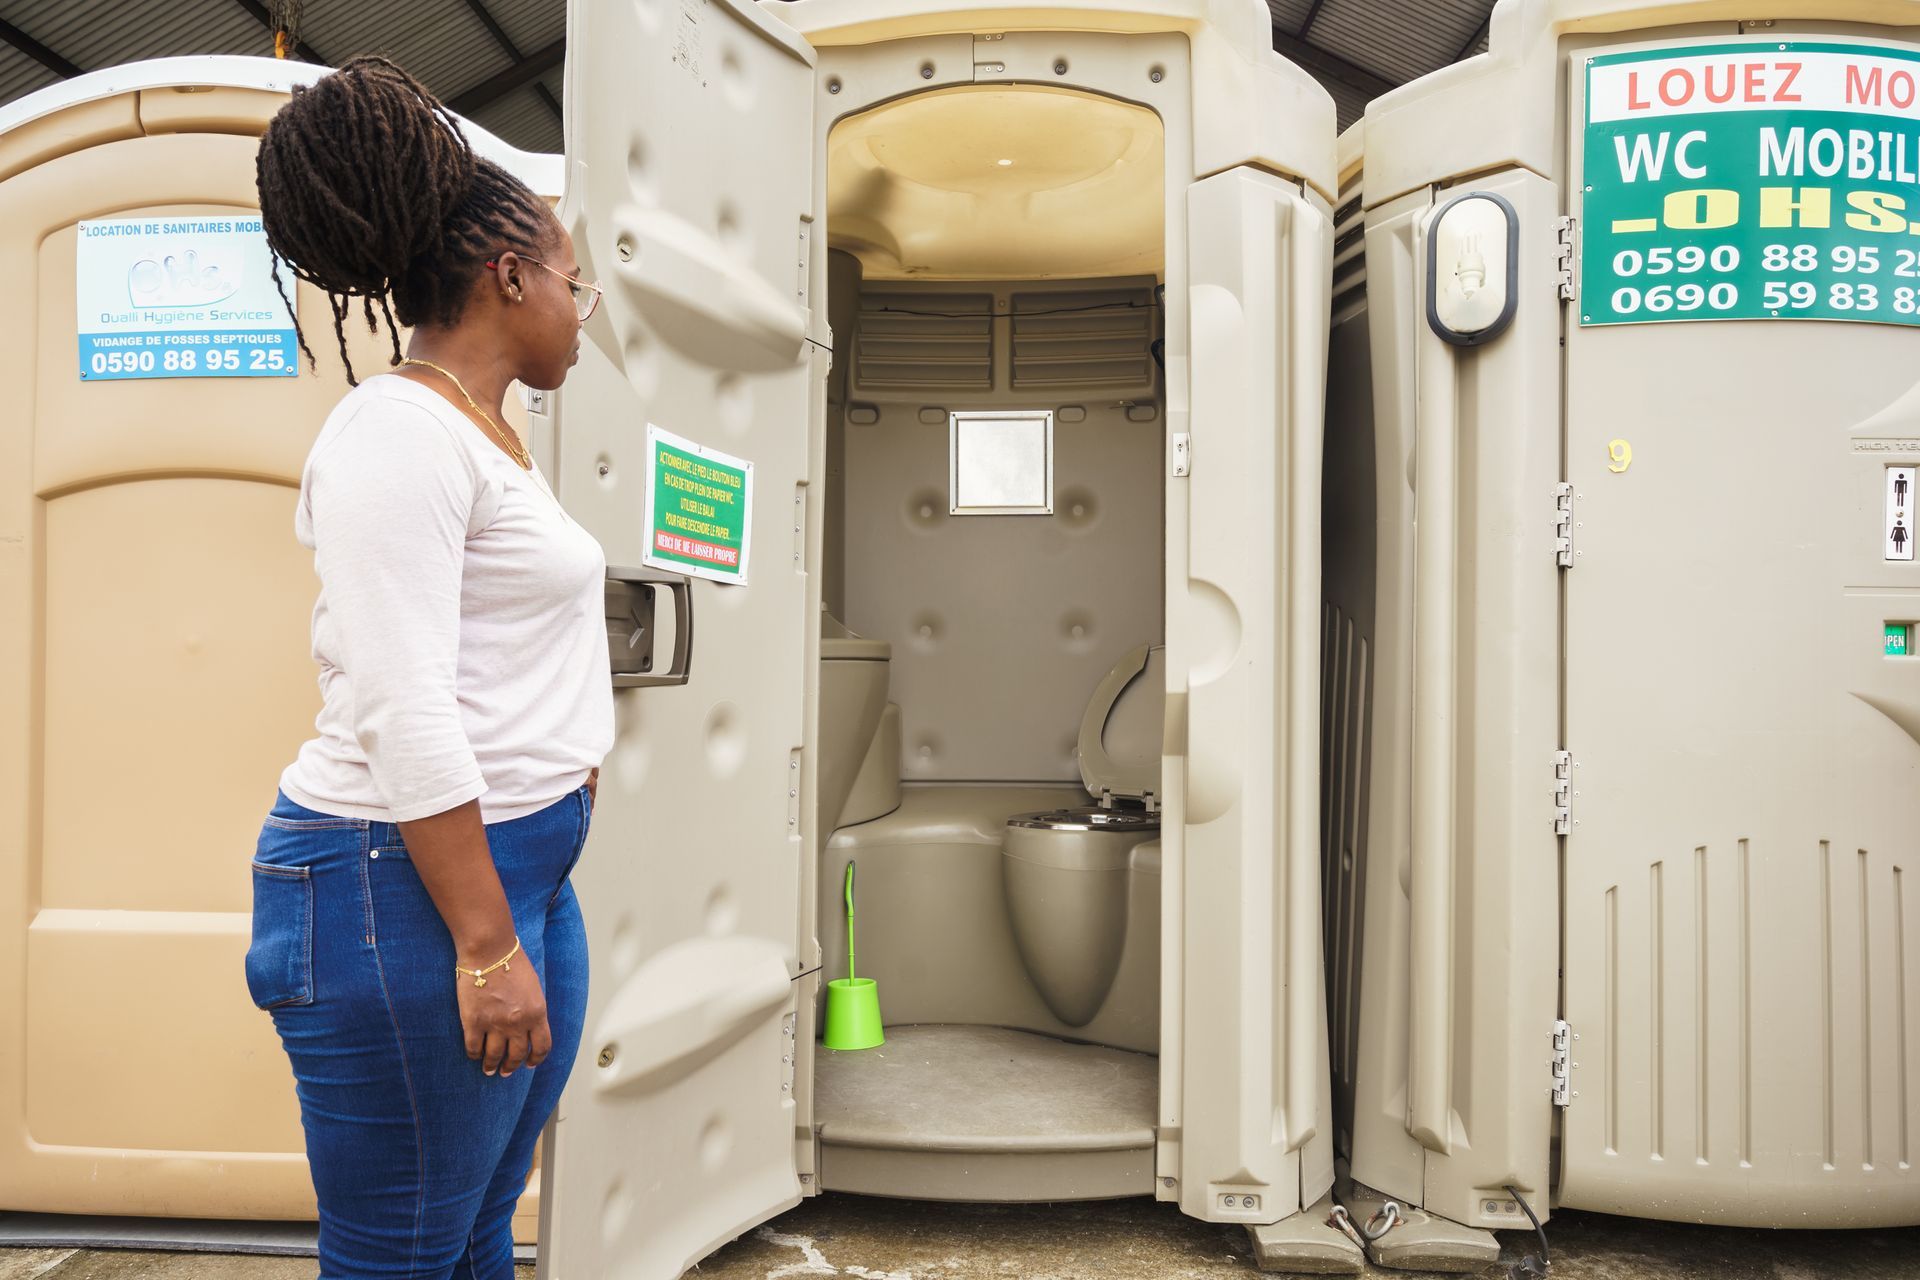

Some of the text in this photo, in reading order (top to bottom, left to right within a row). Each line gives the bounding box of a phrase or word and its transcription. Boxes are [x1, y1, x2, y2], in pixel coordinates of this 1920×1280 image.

[1628, 63, 1915, 110] LOUEZ MO
[1613, 127, 1920, 184] WC MOBIL
[86, 222, 264, 237] LOCATION DE SANITAIRES MOB
[1612, 244, 1920, 278] 0590 88 95 2
[1611, 281, 1920, 314] 0690 59 83 8
[144, 311, 204, 324] Hygiène
[210, 310, 273, 320] Services
[93, 334, 281, 347] VIDANGE DE FOSSES SEPTIQUES
[92, 349, 284, 373] 0590 88 95 25
[1608, 439, 1632, 472] 9
[657, 534, 673, 549] MERCI
[674, 538, 681, 551] DE
[691, 542, 713, 558] LAISSER
[713, 547, 736, 563] PROPRE
[1884, 635, 1904, 646] PEN
